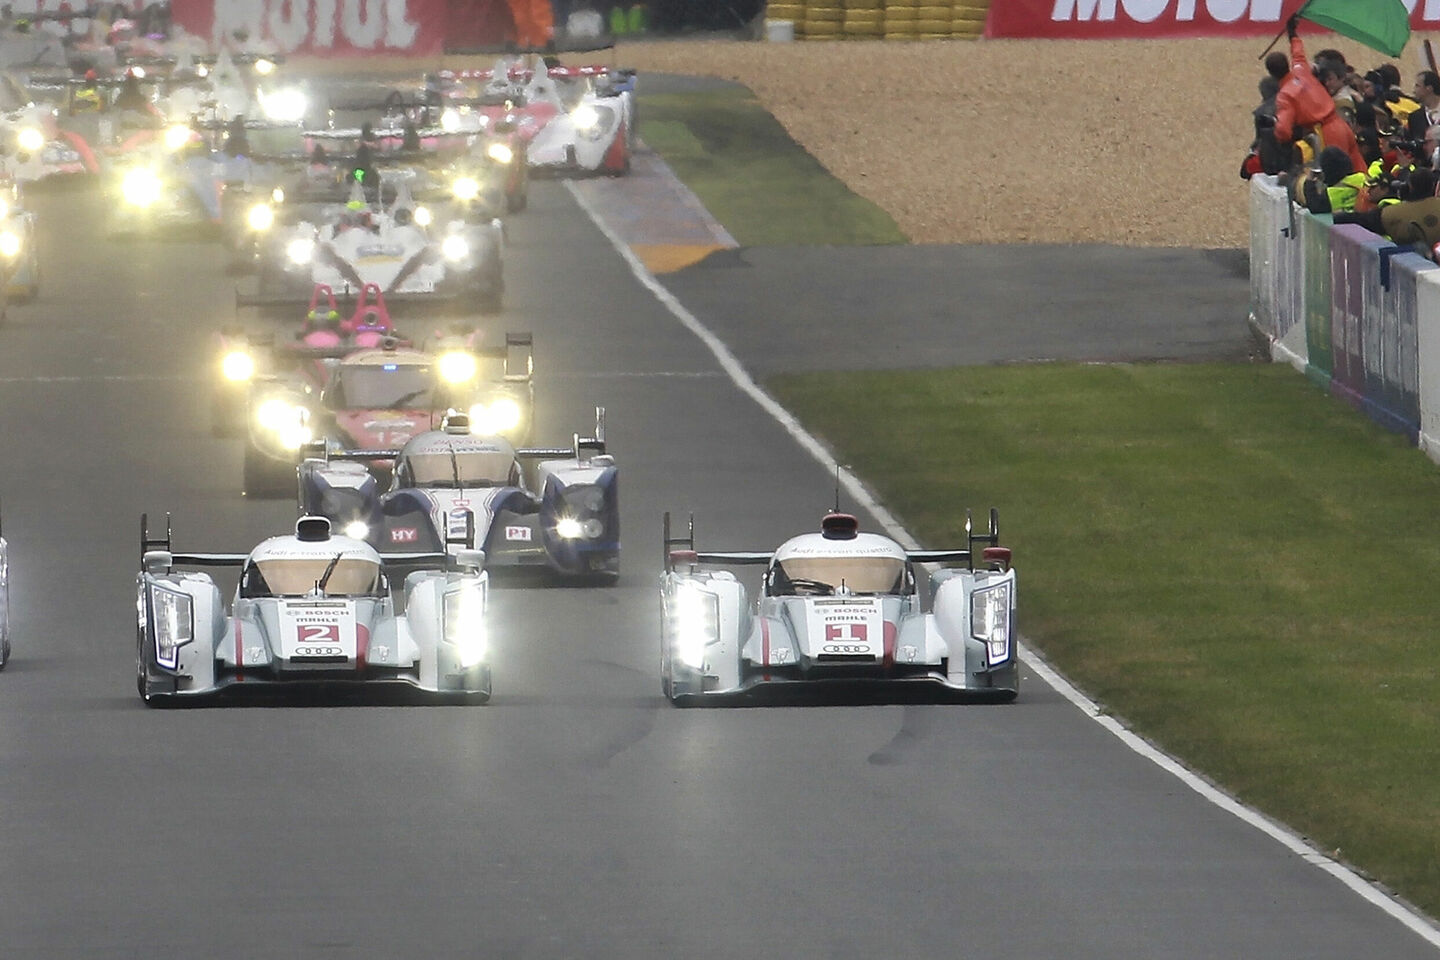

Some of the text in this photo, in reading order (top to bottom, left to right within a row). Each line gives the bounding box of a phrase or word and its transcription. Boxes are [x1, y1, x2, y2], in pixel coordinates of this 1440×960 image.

[392, 530, 415, 540] HY
[509, 527, 527, 538] P1
[304, 626, 333, 641] 2
[832, 625, 861, 641] 1
